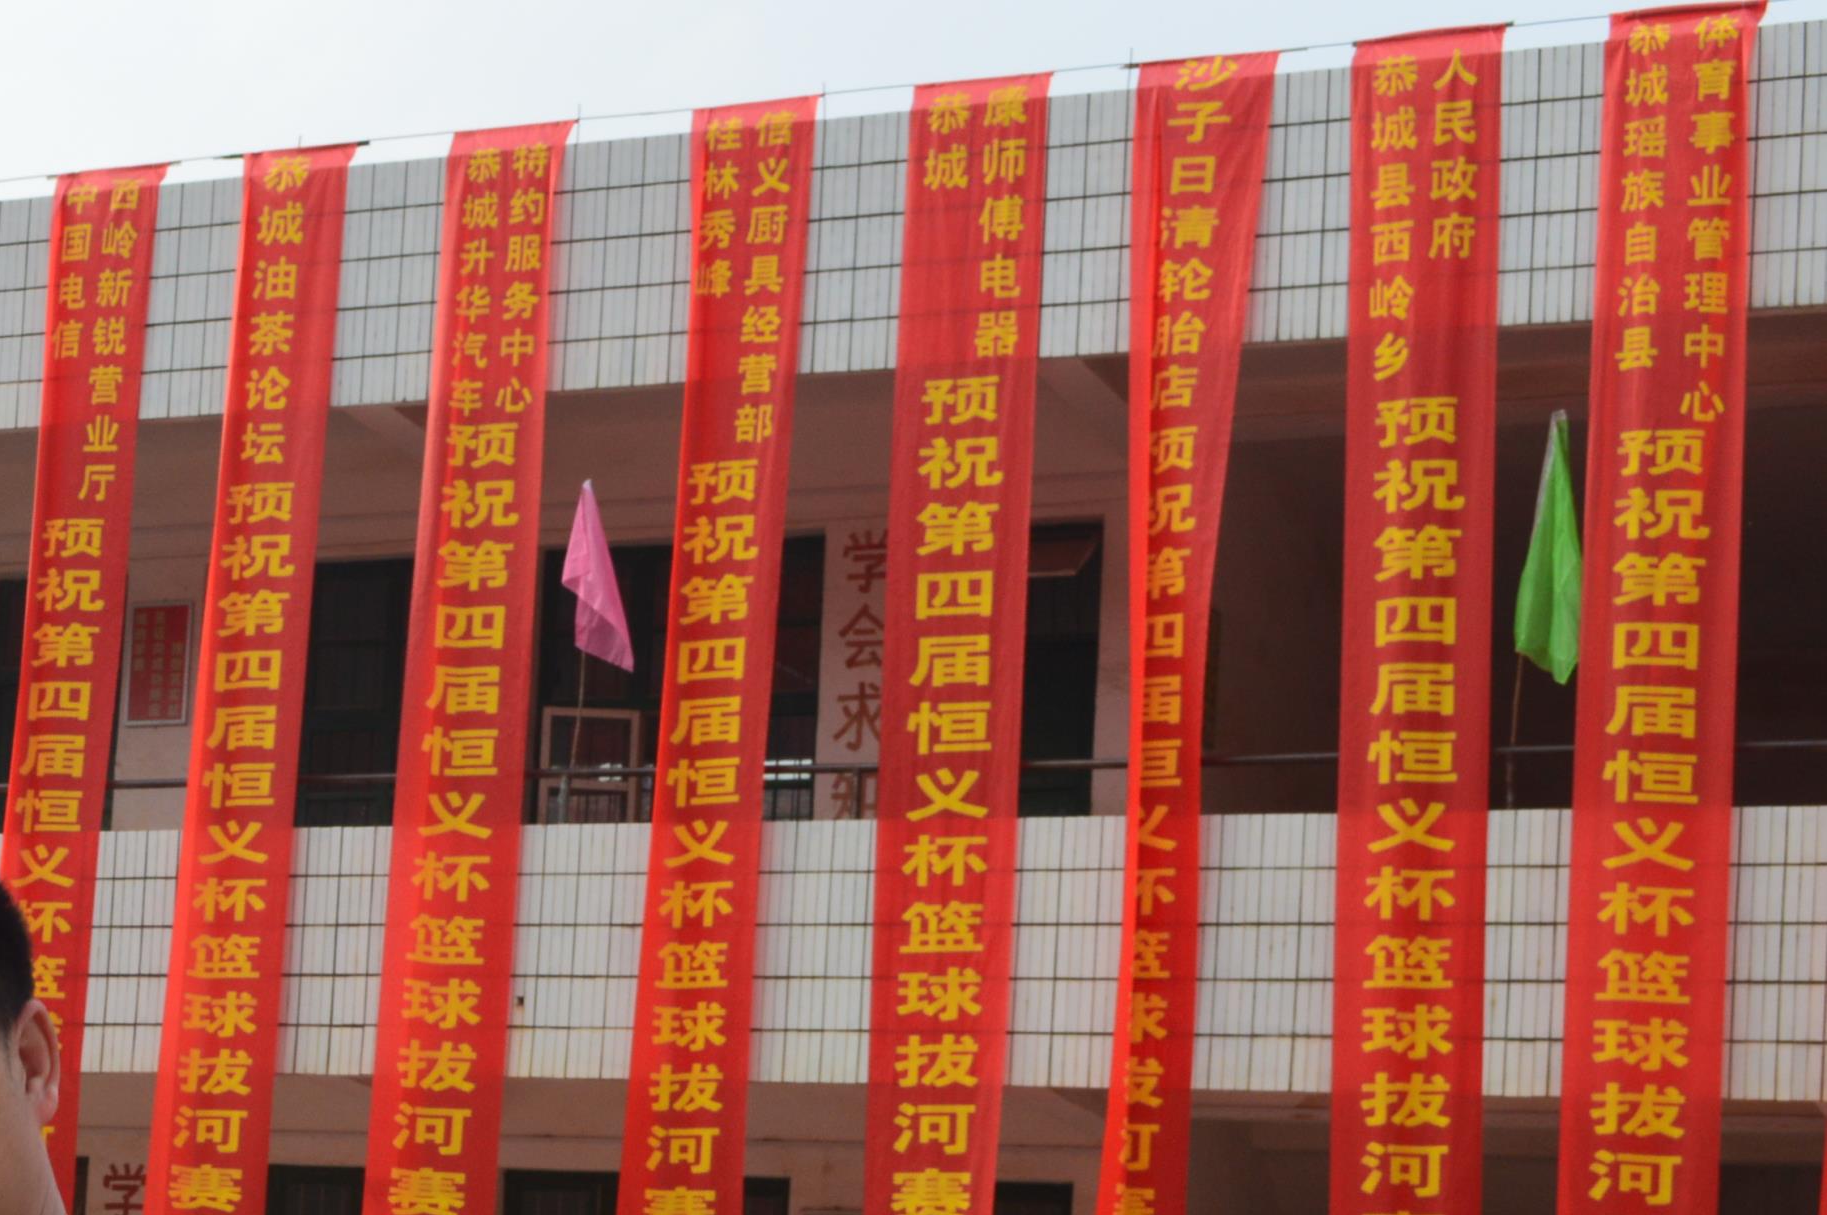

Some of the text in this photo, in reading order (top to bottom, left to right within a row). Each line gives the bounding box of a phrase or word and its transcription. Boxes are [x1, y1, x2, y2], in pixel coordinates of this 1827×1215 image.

[53, 185, 98, 357] 中国电信
[696, 117, 742, 297] 桂林秀峰
[924, 91, 971, 190] 恭城
[975, 85, 1028, 357] 康师傅电器
[1369, 55, 1418, 381] 恭城县西岭乡
[1429, 48, 1479, 257] 人民政府
[1615, 24, 1671, 371] 恭城瑶族自治县
[1680, 15, 1739, 422] 体育事业管理中心
[77, 179, 141, 501] 西岭新锐营业厅
[448, 148, 501, 416] 恭城升华汽车
[495, 144, 548, 413] 特约服务中心
[735, 111, 796, 442] 信义厨具经营部
